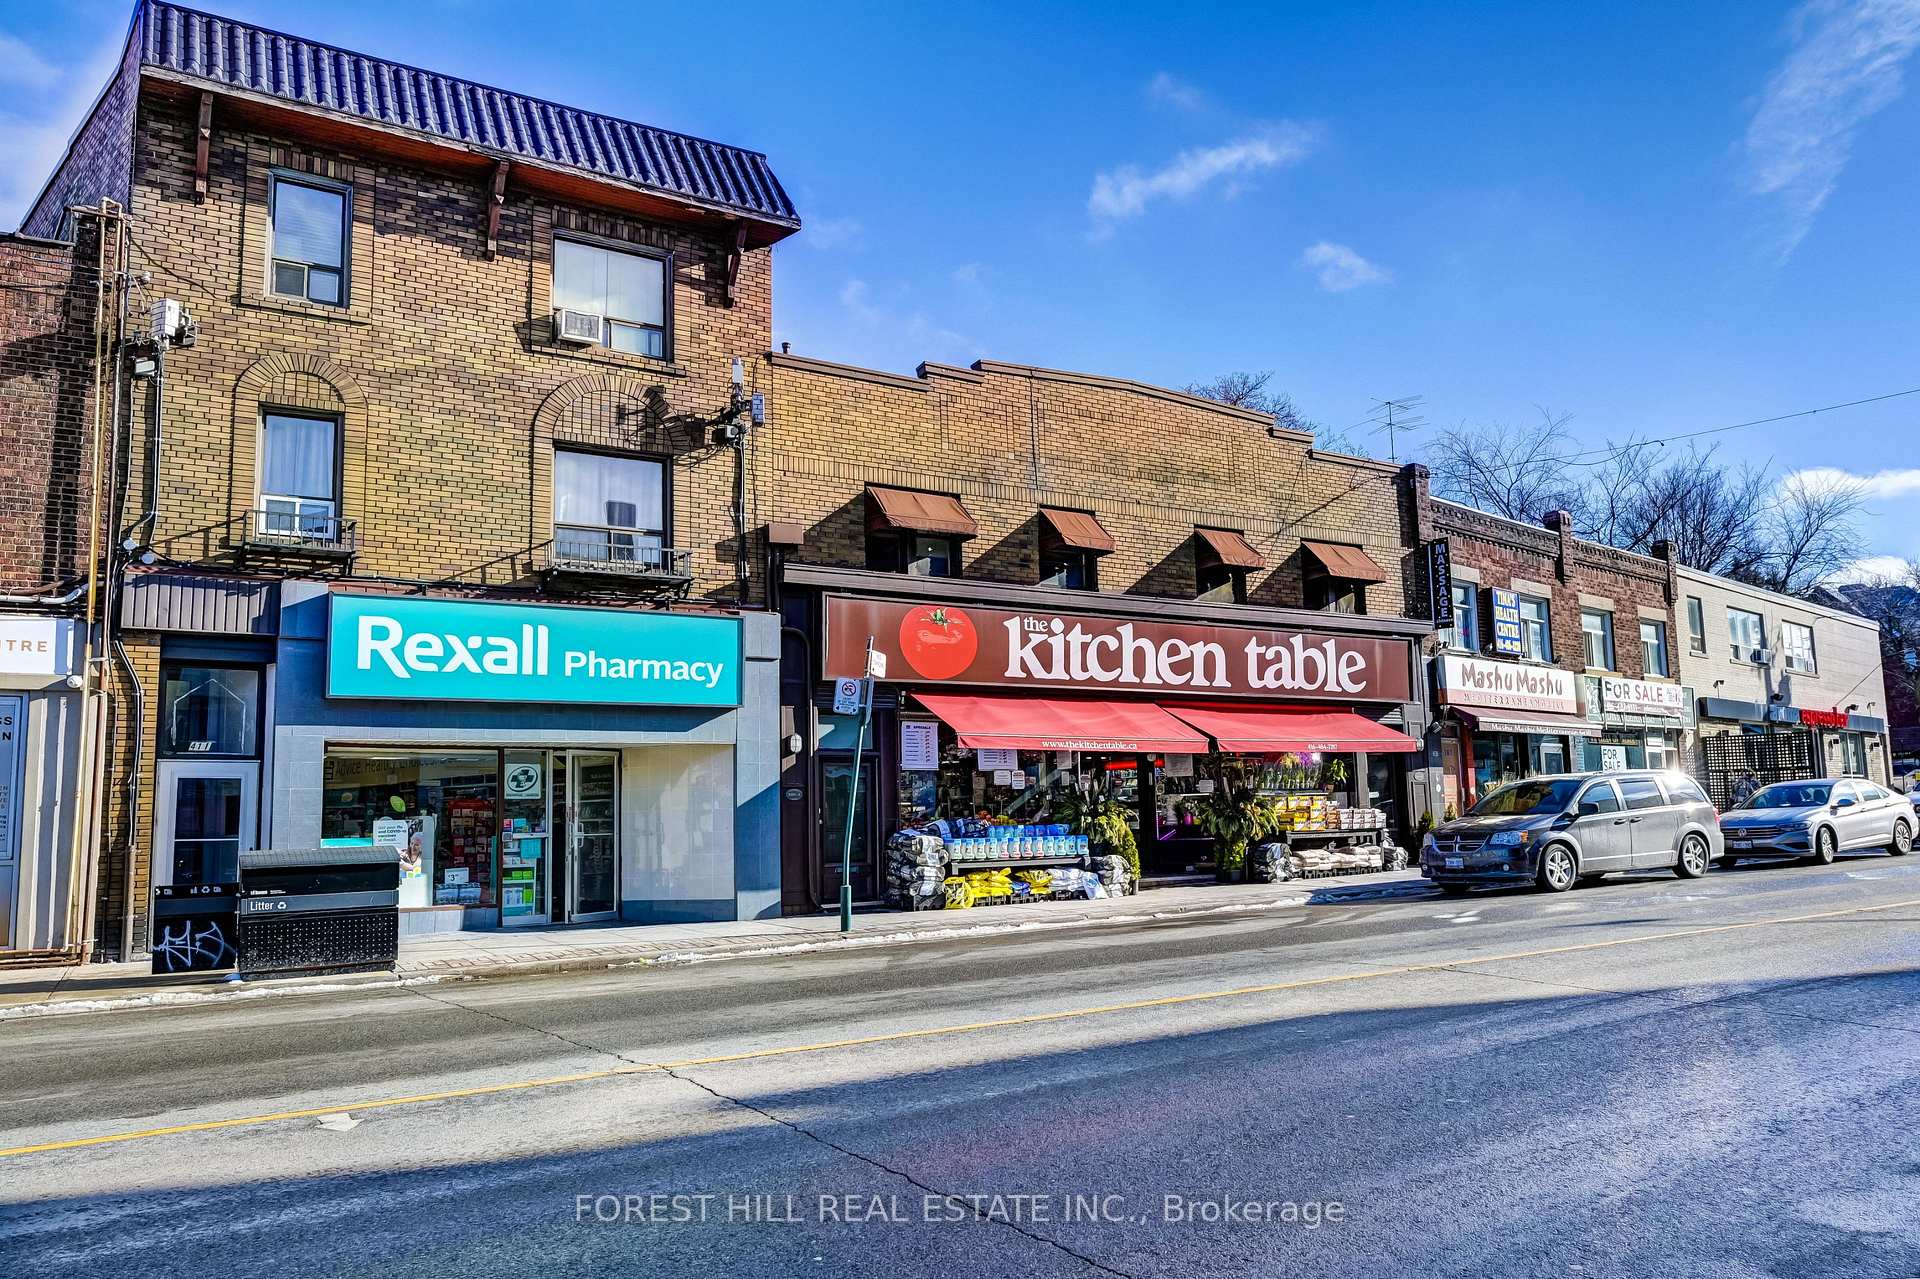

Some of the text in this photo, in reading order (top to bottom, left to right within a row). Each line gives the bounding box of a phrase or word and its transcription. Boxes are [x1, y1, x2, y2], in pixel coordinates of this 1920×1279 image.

[1435, 543, 1449, 618] MASSAGE
[1023, 615, 1049, 632] the
[1, 640, 48, 652] TRE
[357, 615, 724, 689] Rexall Pharmacy
[1003, 616, 1368, 695] kitchen table
[1462, 662, 1563, 696] Mashu Mashu
[1604, 680, 1630, 699] FOR
[1634, 684, 1663, 702] SALE
[1041, 741, 1138, 750] www.thekitchentable.ca
[1602, 748, 1617, 760] FOR
[1603, 761, 1621, 771] SALE
[250, 901, 275, 911] Litter
